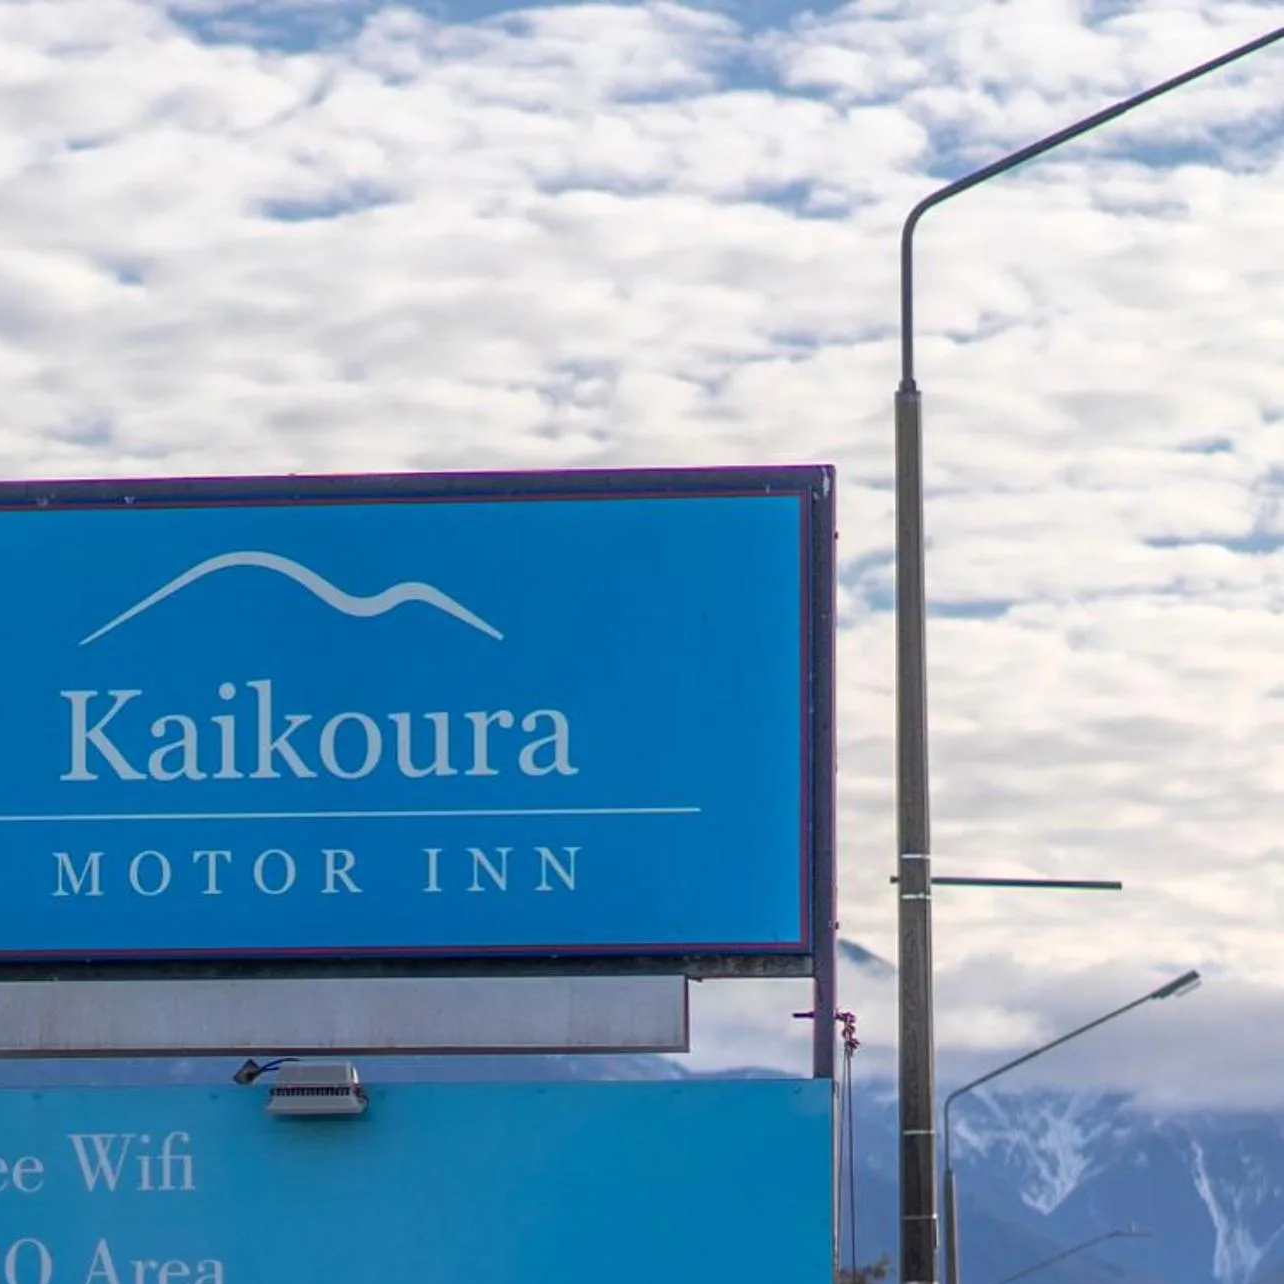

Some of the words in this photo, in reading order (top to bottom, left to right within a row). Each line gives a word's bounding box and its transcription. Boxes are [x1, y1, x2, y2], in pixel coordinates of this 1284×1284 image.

[60, 679, 579, 781] Kaikoura
[53, 849, 362, 896] MOTOR
[424, 846, 580, 892] INN
[69, 1131, 196, 1191] Wifi
